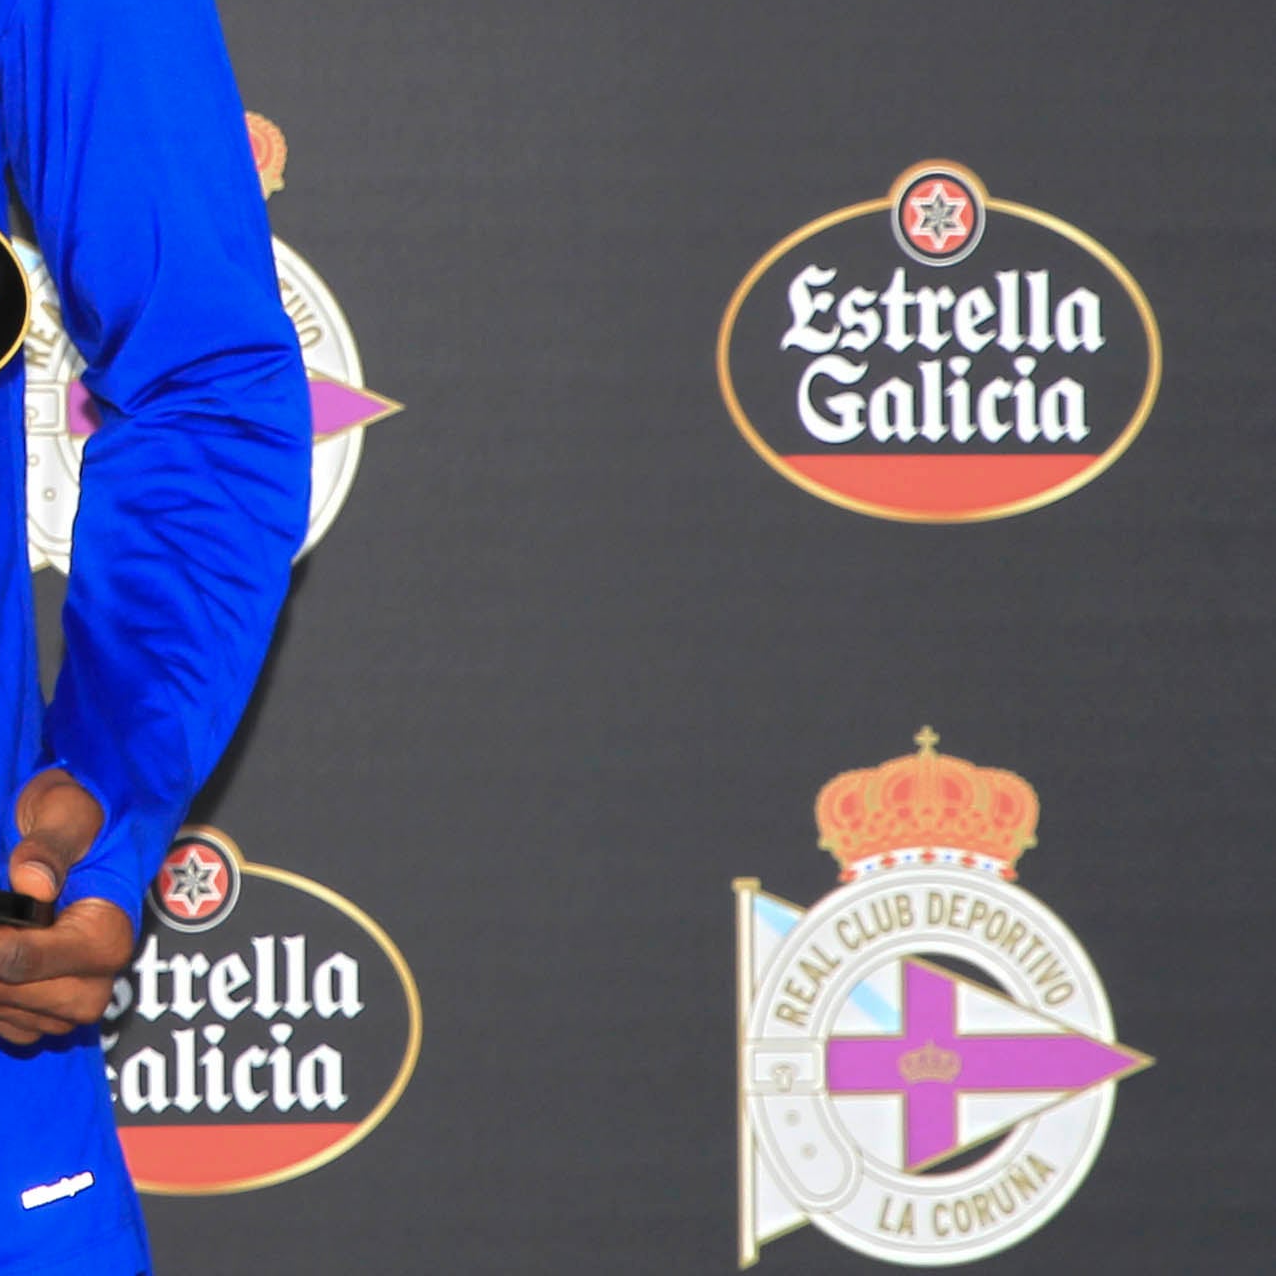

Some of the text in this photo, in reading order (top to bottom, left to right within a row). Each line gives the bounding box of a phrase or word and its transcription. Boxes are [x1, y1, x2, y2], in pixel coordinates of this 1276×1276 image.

[780, 264, 1104, 353] Estrella
[797, 354, 1089, 443] Galicia
[103, 933, 364, 1021] trella
[776, 892, 1075, 1028] REAL CLUB DEPORTIVO
[100, 1024, 347, 1113] alicia
[877, 1196, 916, 1237] LA
